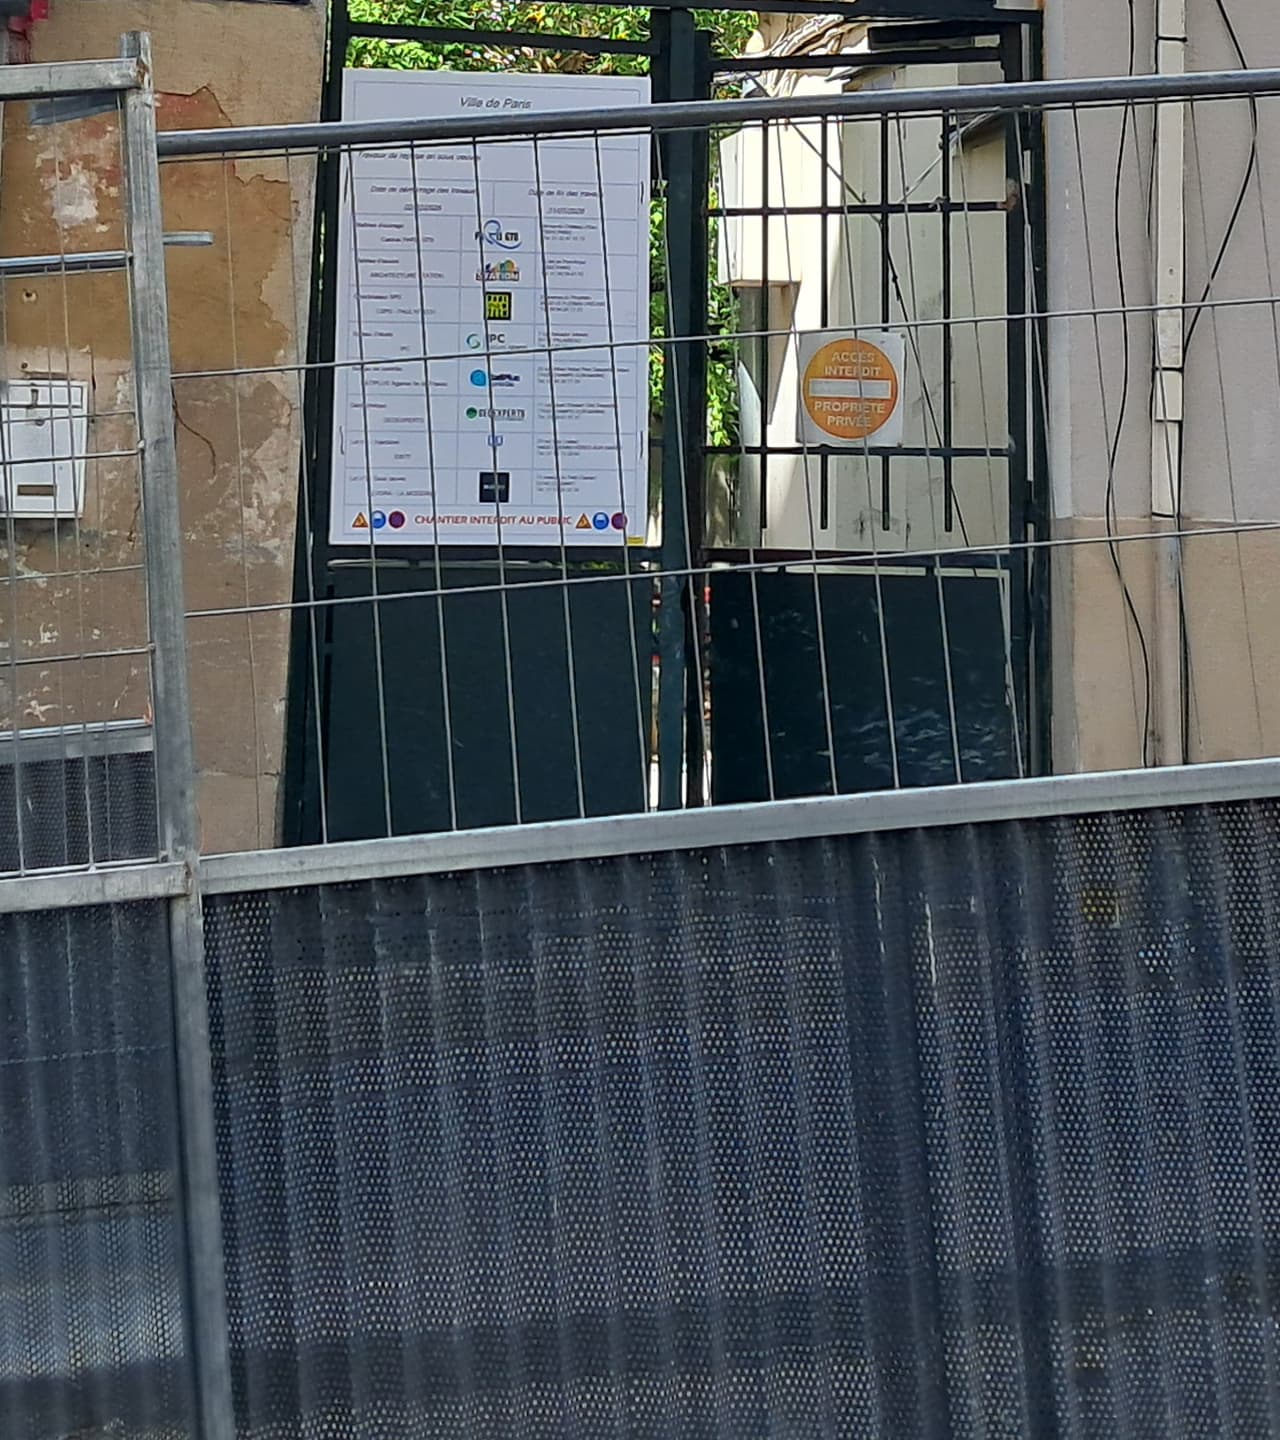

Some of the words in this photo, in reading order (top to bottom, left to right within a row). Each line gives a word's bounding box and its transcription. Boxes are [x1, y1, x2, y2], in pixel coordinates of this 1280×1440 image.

[460, 96, 483, 108] Ville
[486, 98, 500, 109] de
[503, 98, 531, 109] Paris
[486, 333, 505, 344] PC
[414, 515, 467, 524] CHANTIER
[519, 516, 534, 524] AU
[537, 516, 572, 525] PUBIC
